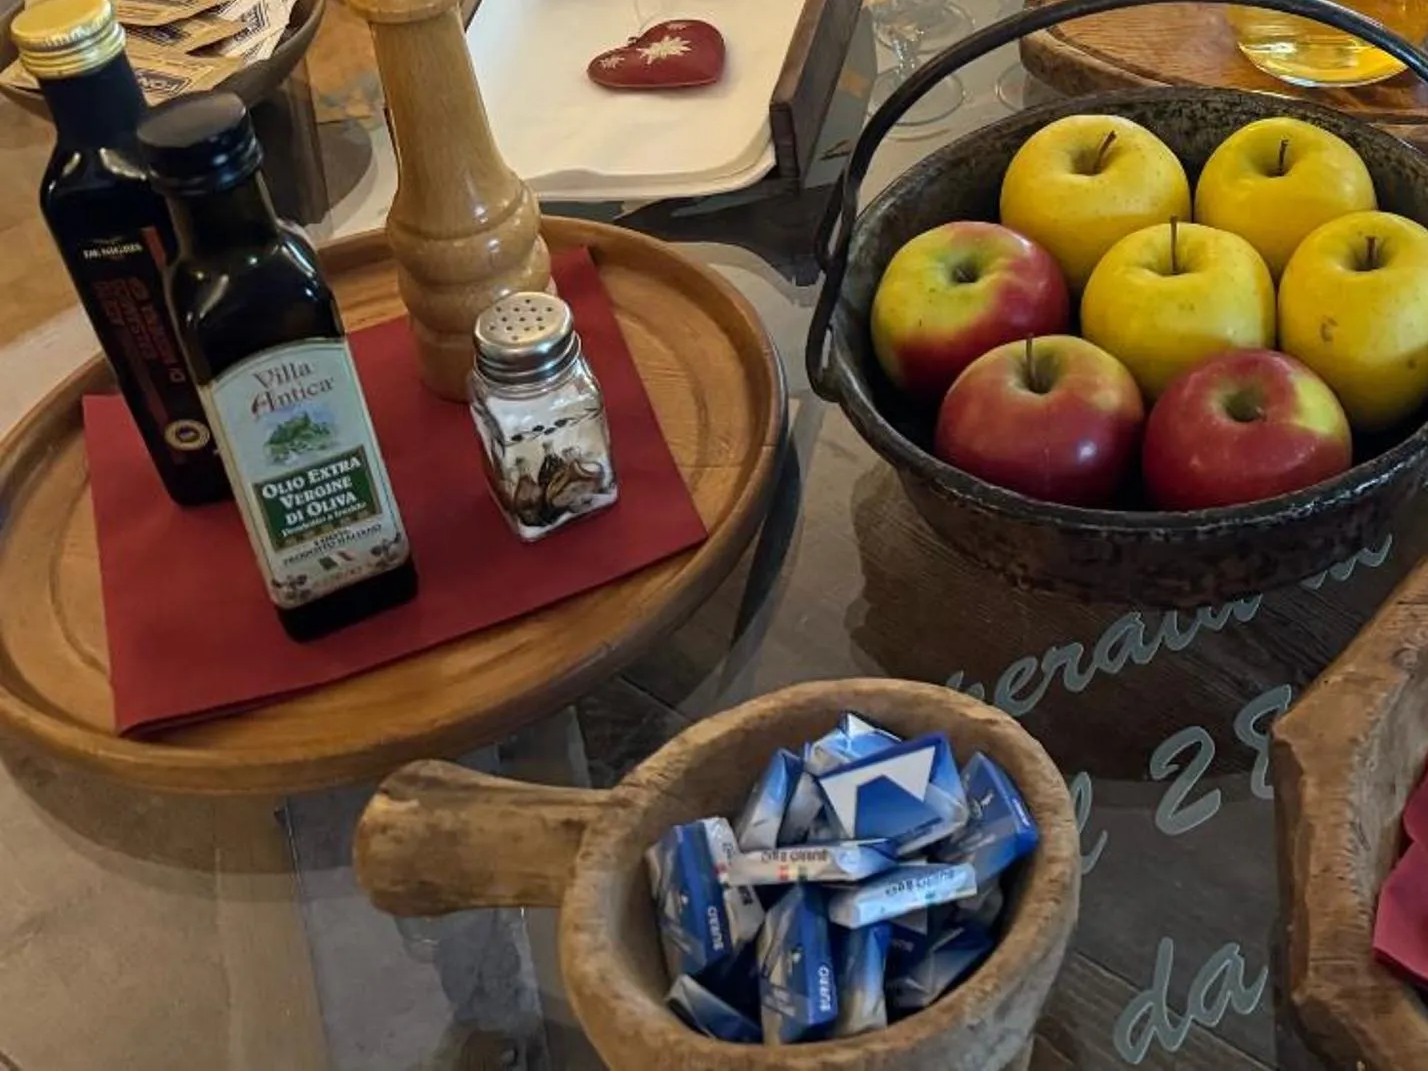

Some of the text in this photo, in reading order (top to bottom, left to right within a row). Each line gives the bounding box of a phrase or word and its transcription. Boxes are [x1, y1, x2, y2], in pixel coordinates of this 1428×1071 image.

[252, 361, 314, 389] Villa
[251, 378, 333, 419] Antica
[262, 457, 361, 500] OLIO EXTRA
[280, 476, 353, 509] VERGINE
[307, 491, 358, 517] OLIVA
